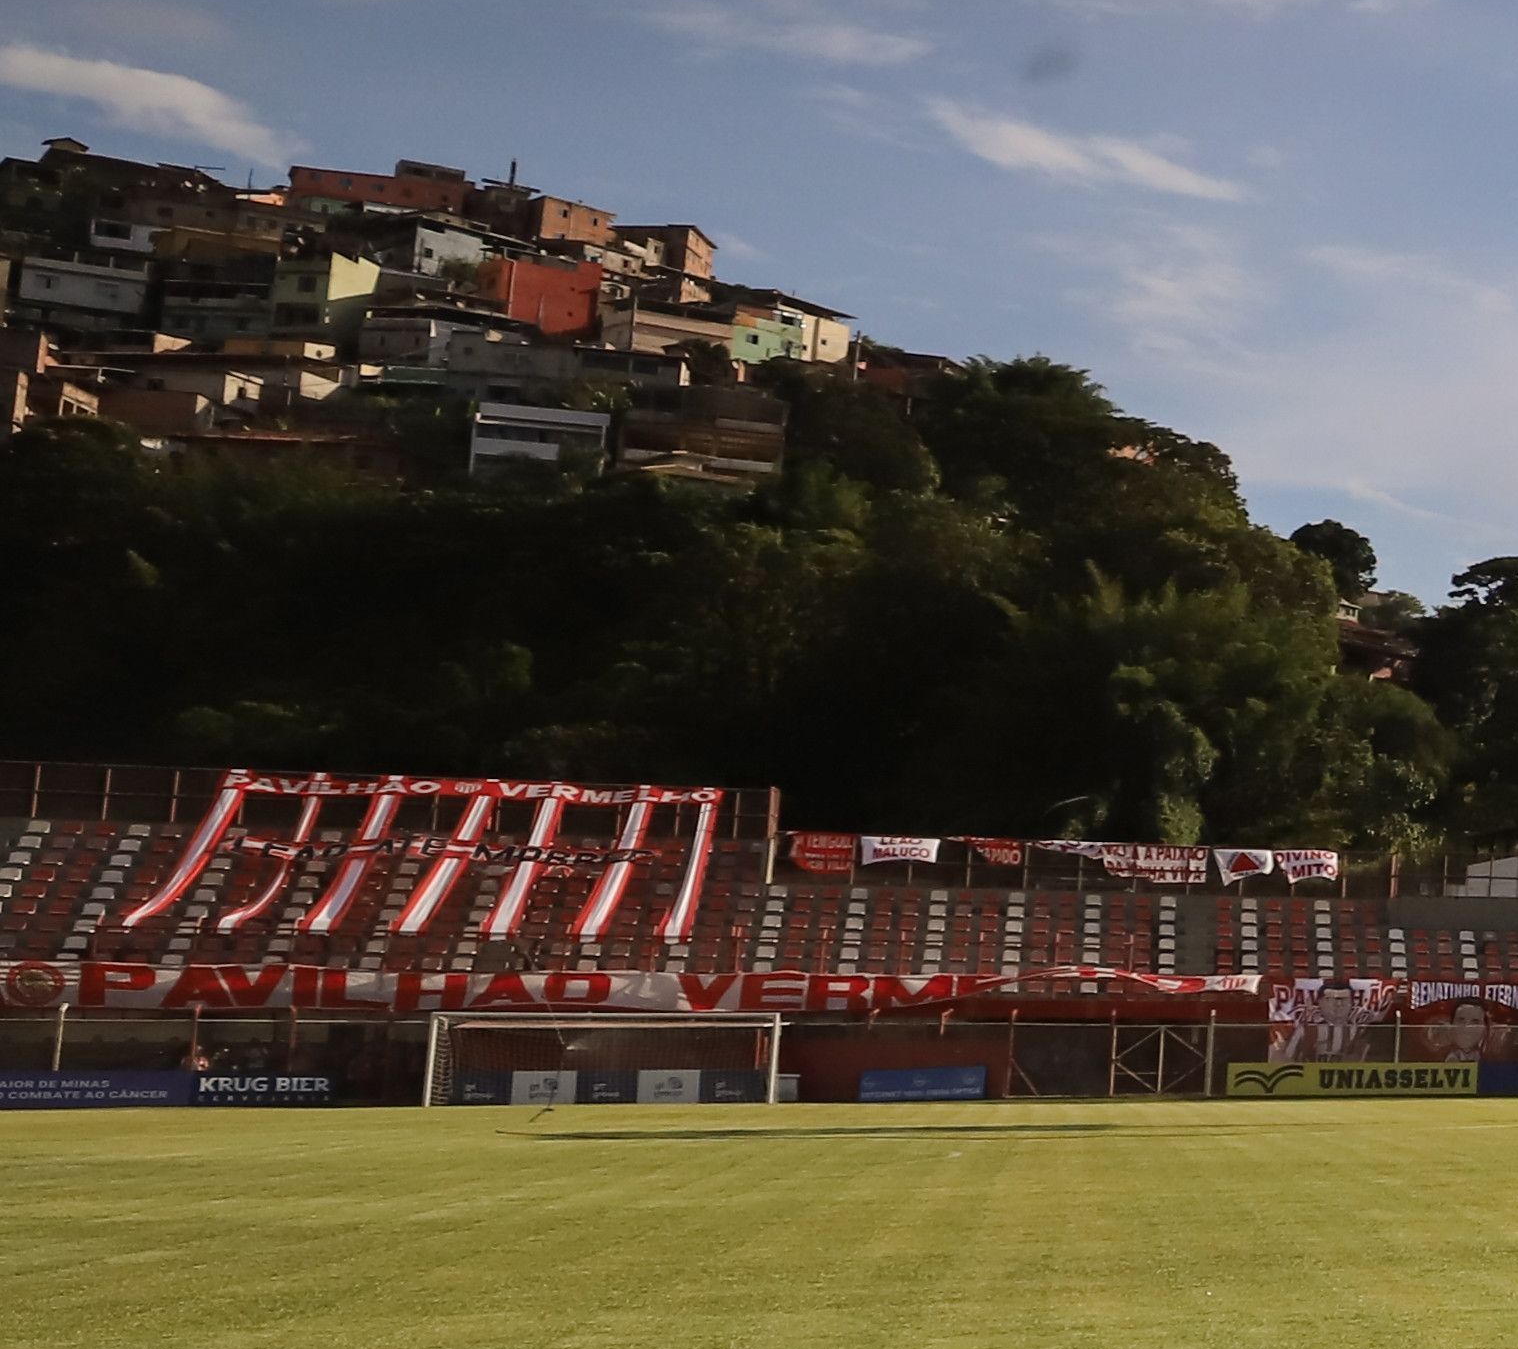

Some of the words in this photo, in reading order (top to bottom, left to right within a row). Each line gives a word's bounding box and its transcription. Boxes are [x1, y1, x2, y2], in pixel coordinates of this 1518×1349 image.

[498, 782, 717, 803] VERMELHO
[873, 846, 930, 859] MALUCO
[1274, 851, 1333, 863] DIVINO
[1292, 863, 1335, 878] MITO
[1410, 981, 1480, 1009] RENATINHO
[38, 1080, 59, 1089] DE
[61, 1080, 111, 1089] MINAS
[198, 1077, 269, 1092] KRUG
[276, 1077, 330, 1092] BIER
[1318, 1068, 1471, 1090] UNIASSELVI
[8, 1091, 81, 1100] COMBATE
[84, 1091, 106, 1100] AO
[109, 1088, 169, 1099] CÂNCER
